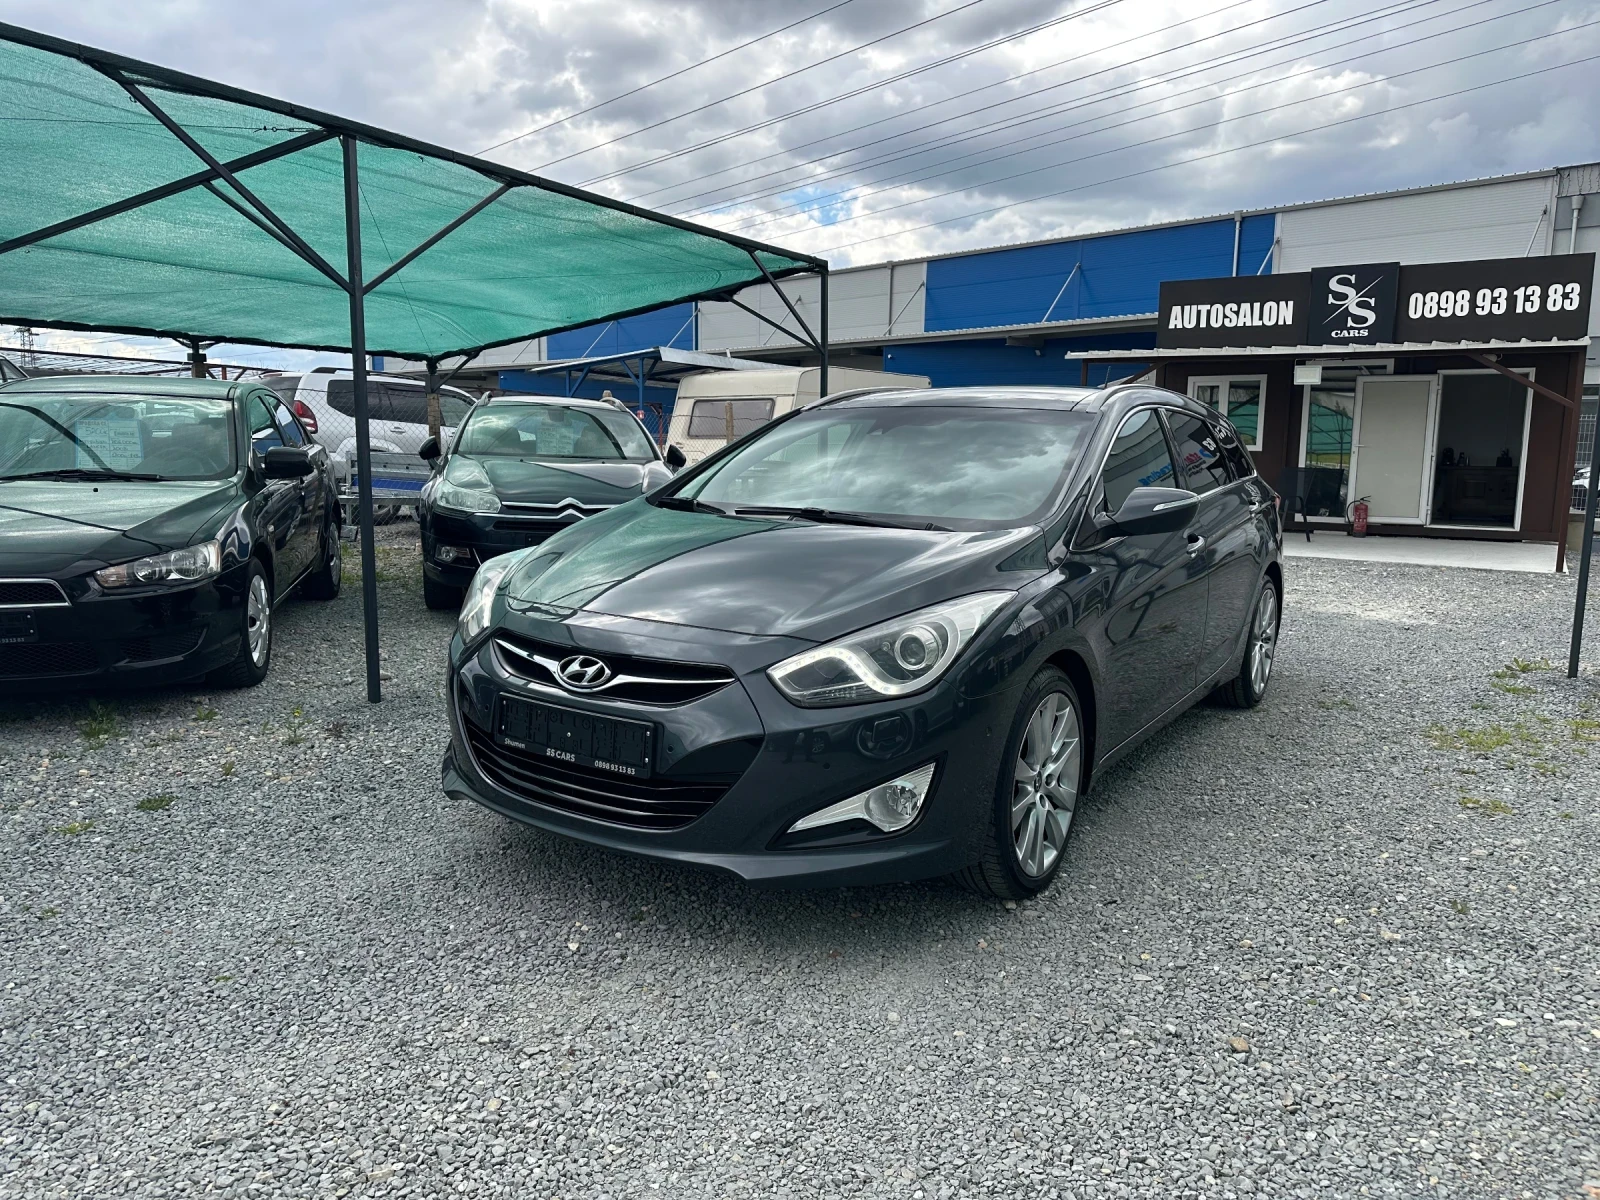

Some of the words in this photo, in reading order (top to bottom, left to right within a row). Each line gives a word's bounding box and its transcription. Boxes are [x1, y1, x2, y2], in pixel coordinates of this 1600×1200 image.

[1408, 289, 1471, 319] 0898
[1475, 287, 1508, 316] 93
[1513, 285, 1542, 314] 13
[1546, 282, 1581, 311] 83
[1168, 300, 1294, 329] AUTOSALON
[1331, 329, 1369, 338] CARS
[504, 737, 526, 749] Shumen
[556, 750, 576, 762] CARS
[594, 760, 610, 771] 0898
[610, 763, 619, 772] 93
[619, 765, 627, 773] 13
[627, 767, 636, 775] 83
